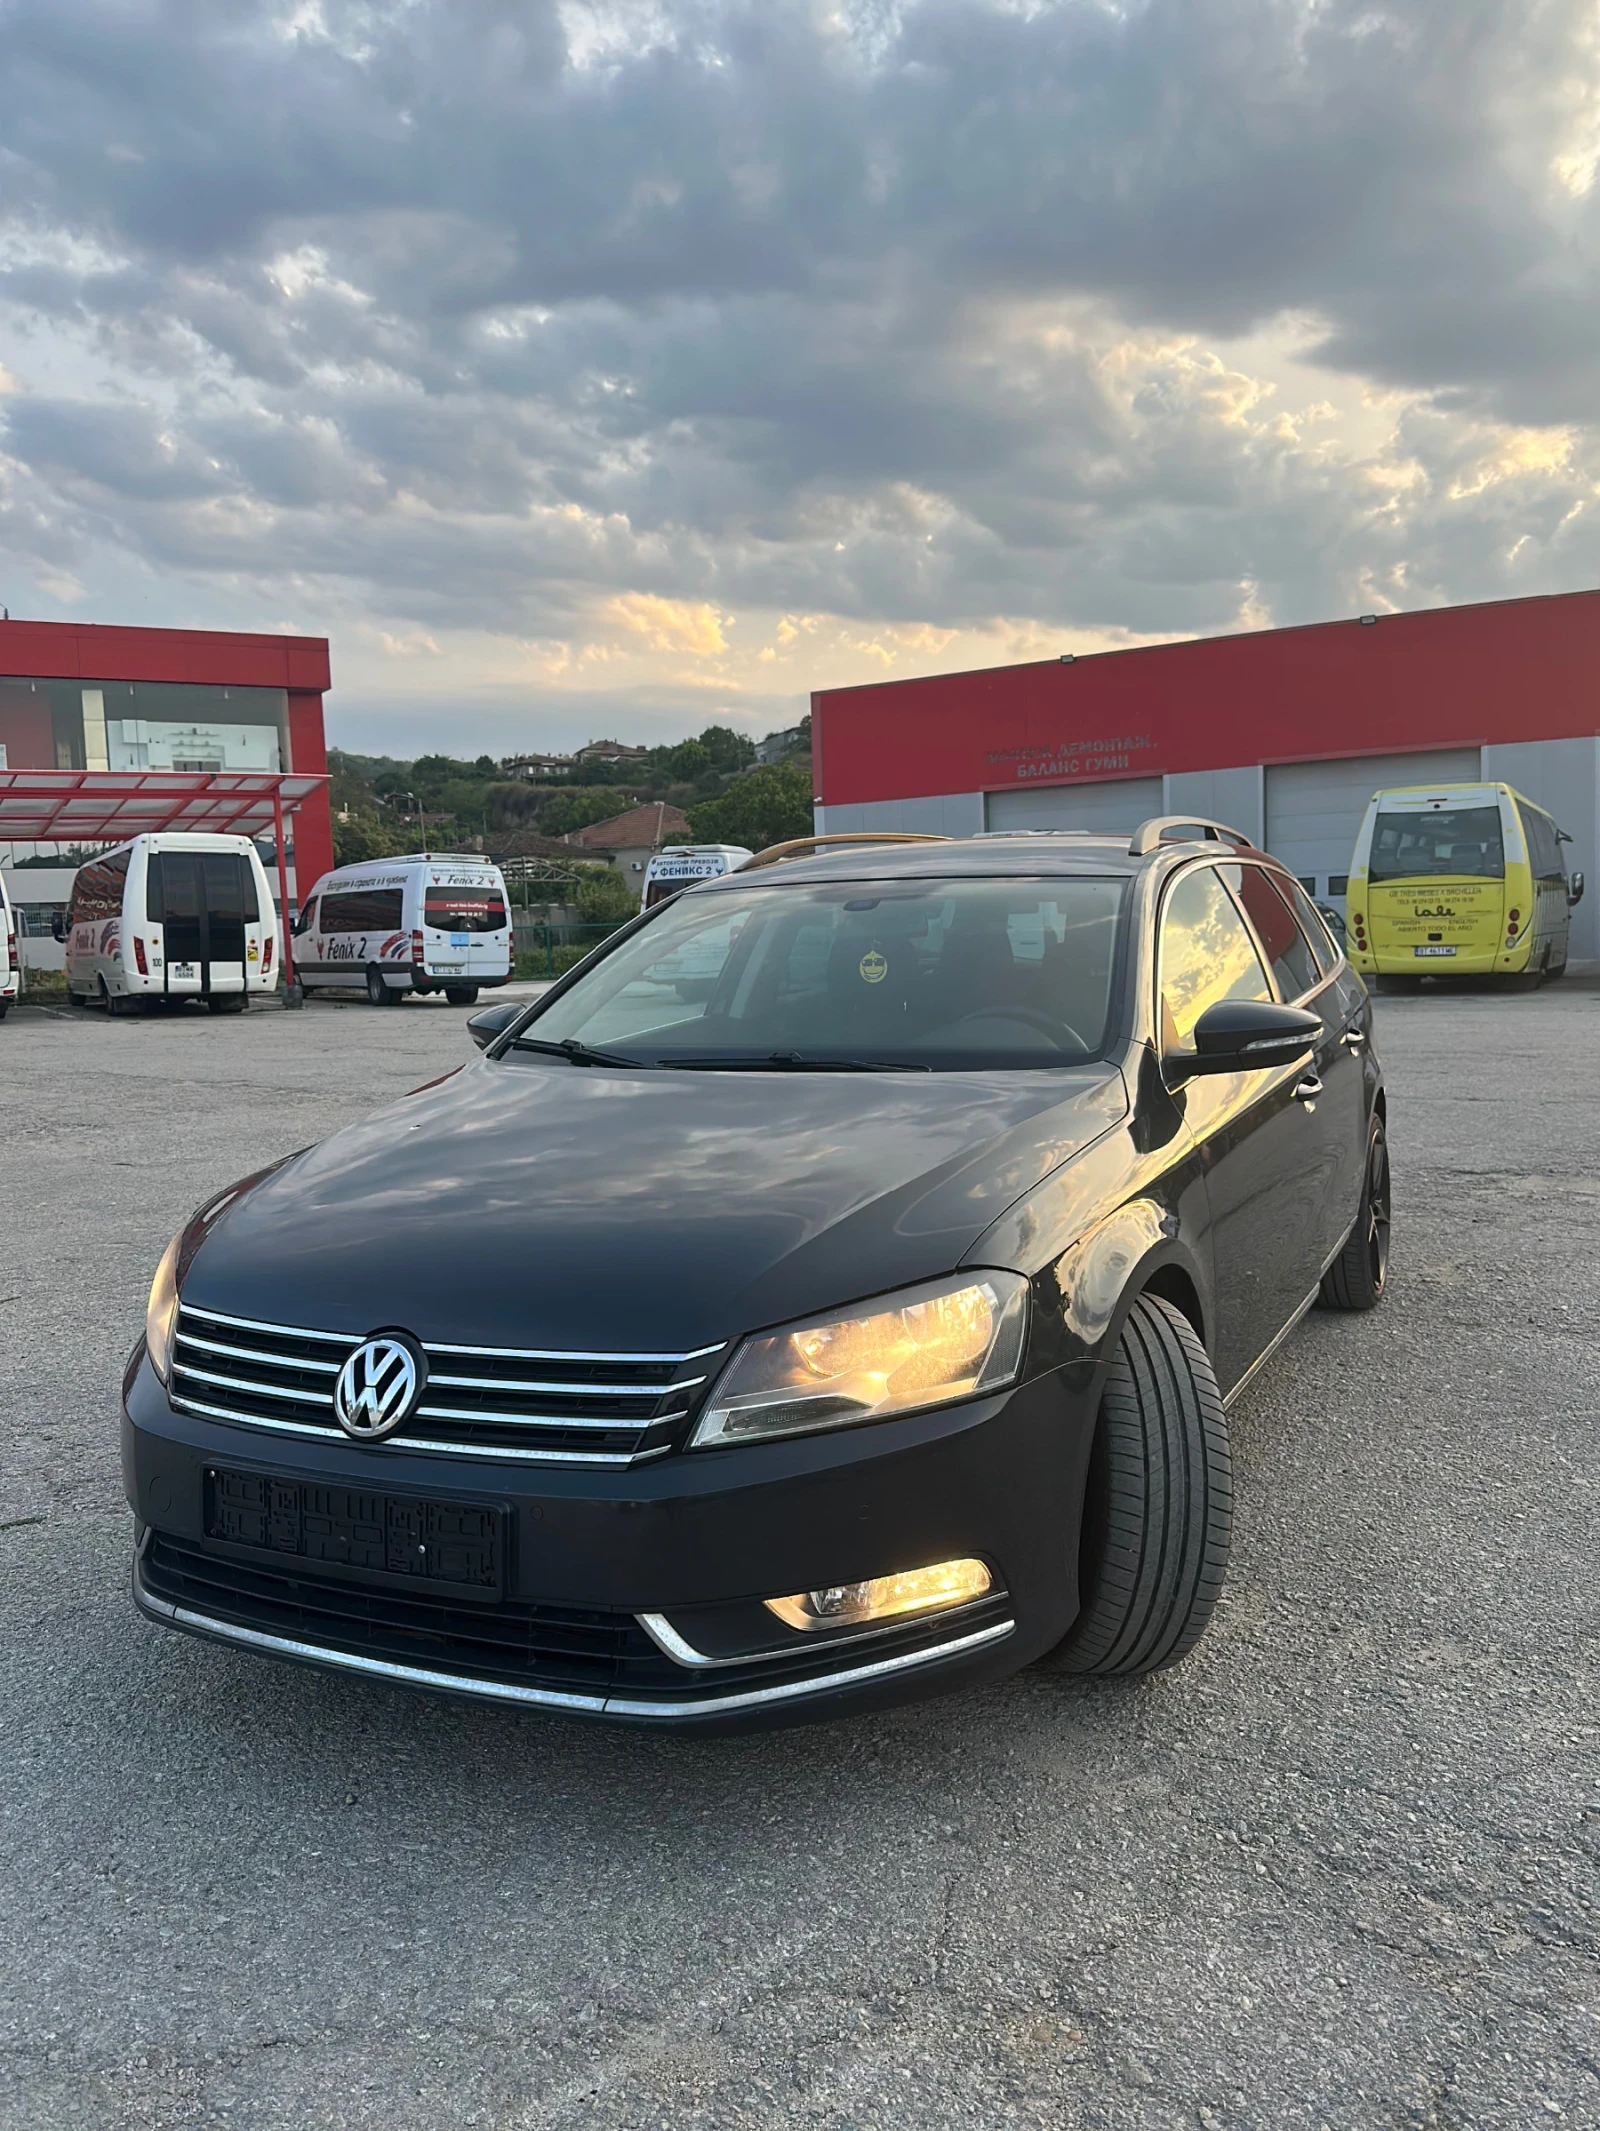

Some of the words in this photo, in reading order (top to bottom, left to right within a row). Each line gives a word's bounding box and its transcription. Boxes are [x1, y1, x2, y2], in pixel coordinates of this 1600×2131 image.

[1017, 760, 1080, 778] БАЛАНС
[1085, 754, 1129, 772] ГУМИ
[660, 866, 703, 877] ФЕНИКС
[705, 866, 712, 876] 2
[447, 875, 475, 885] Fenix
[477, 876, 485, 885] 2
[327, 936, 356, 960] Fenix
[357, 936, 367, 959] 2
[152, 957, 163, 968] 100
